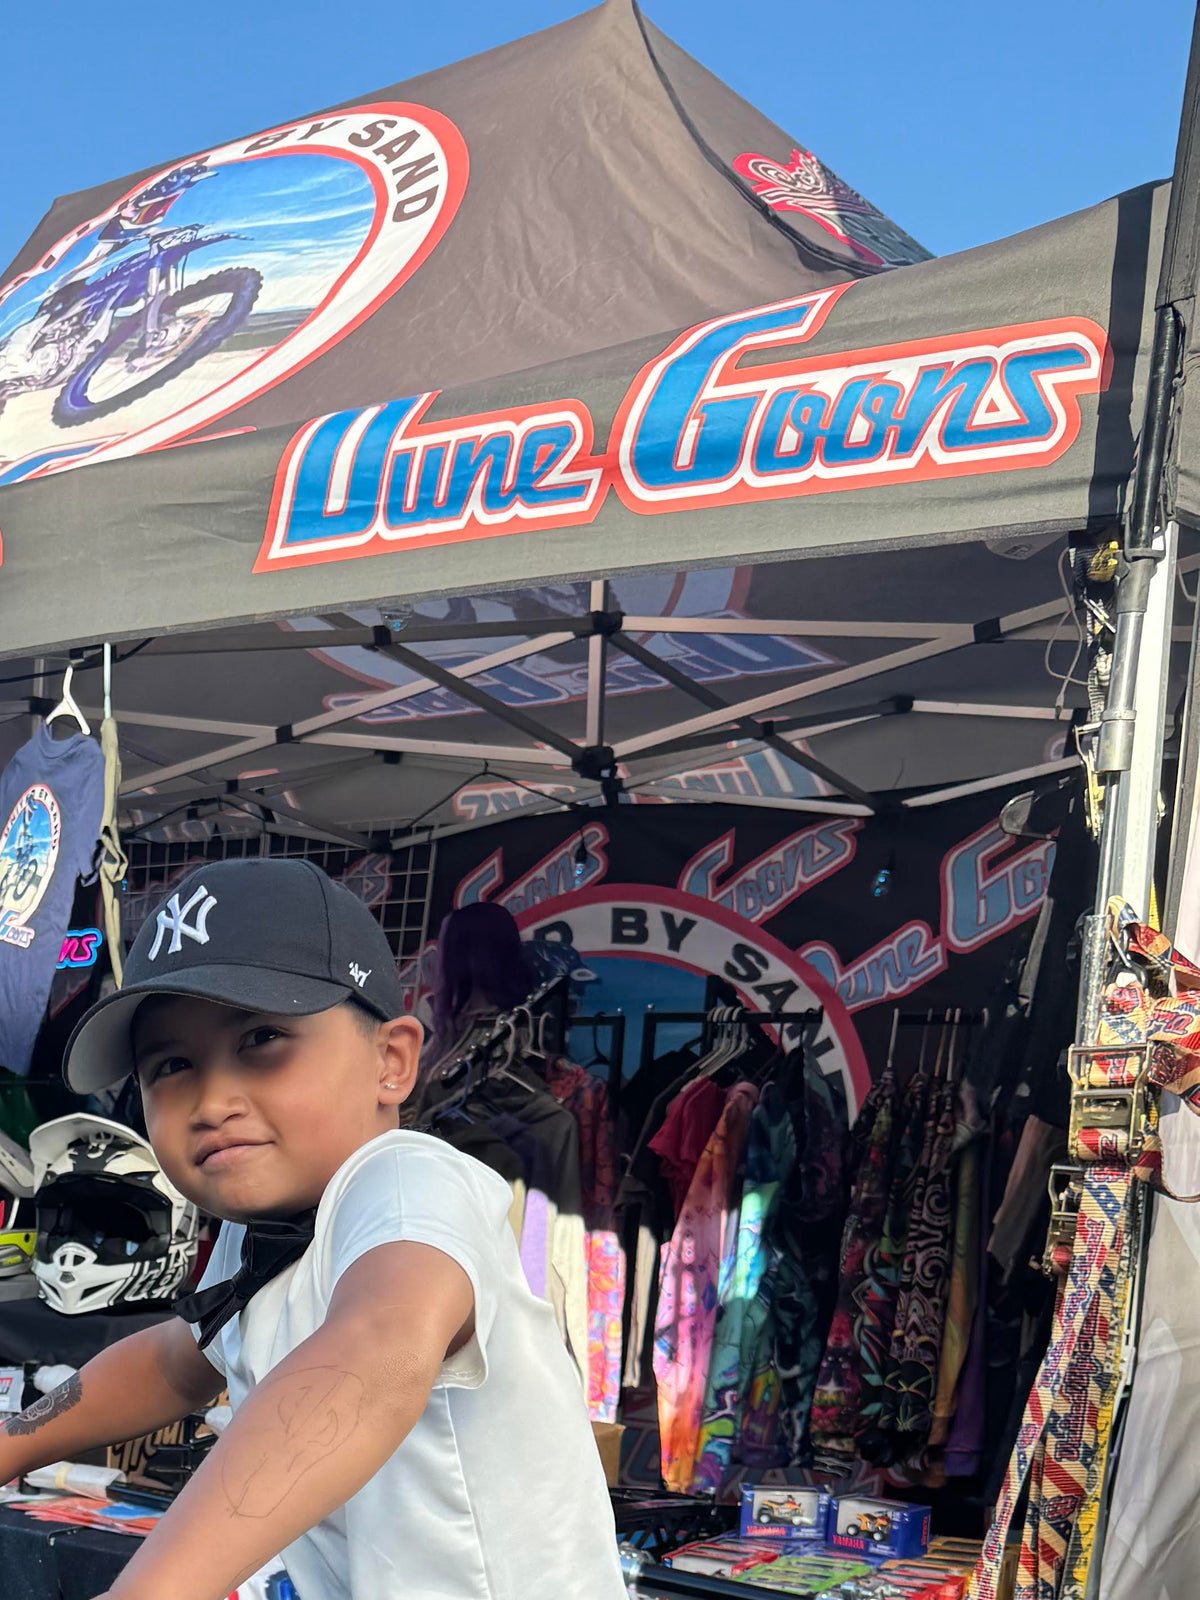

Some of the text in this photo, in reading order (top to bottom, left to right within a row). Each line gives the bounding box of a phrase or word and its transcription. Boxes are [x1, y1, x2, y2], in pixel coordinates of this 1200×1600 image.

[243, 117, 441, 224] BY SAND
[284, 300, 1094, 546] Dune Goons
[148, 884, 218, 961] NY
[611, 906, 697, 954] BY
